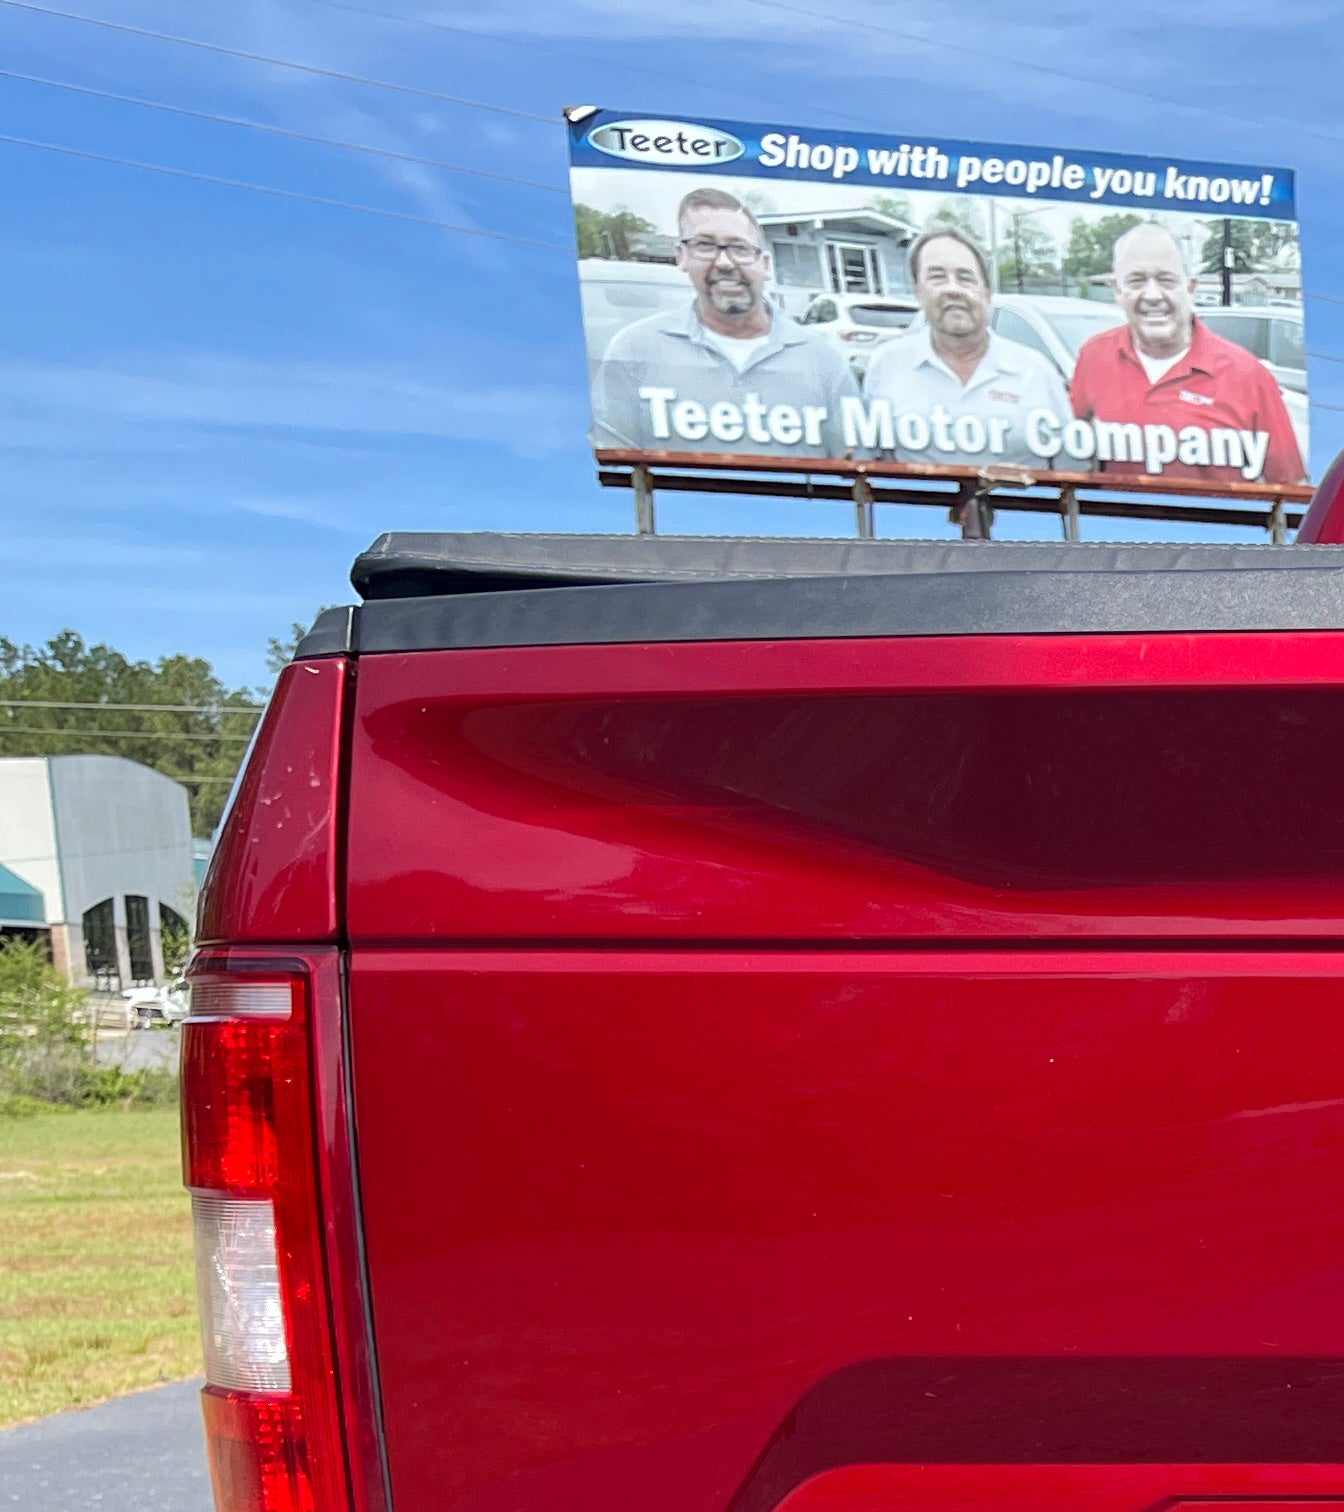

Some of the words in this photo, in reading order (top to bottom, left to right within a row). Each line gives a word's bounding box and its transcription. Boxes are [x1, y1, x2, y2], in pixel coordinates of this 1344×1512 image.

[610, 126, 728, 159] Teeter
[758, 133, 859, 179] Shop
[868, 143, 949, 180] with
[957, 153, 1085, 193] people
[1092, 165, 1156, 201] you
[1165, 166, 1273, 206] know!
[639, 386, 827, 446] Teeter
[840, 397, 1010, 455] Motor
[1026, 409, 1270, 480] Company
